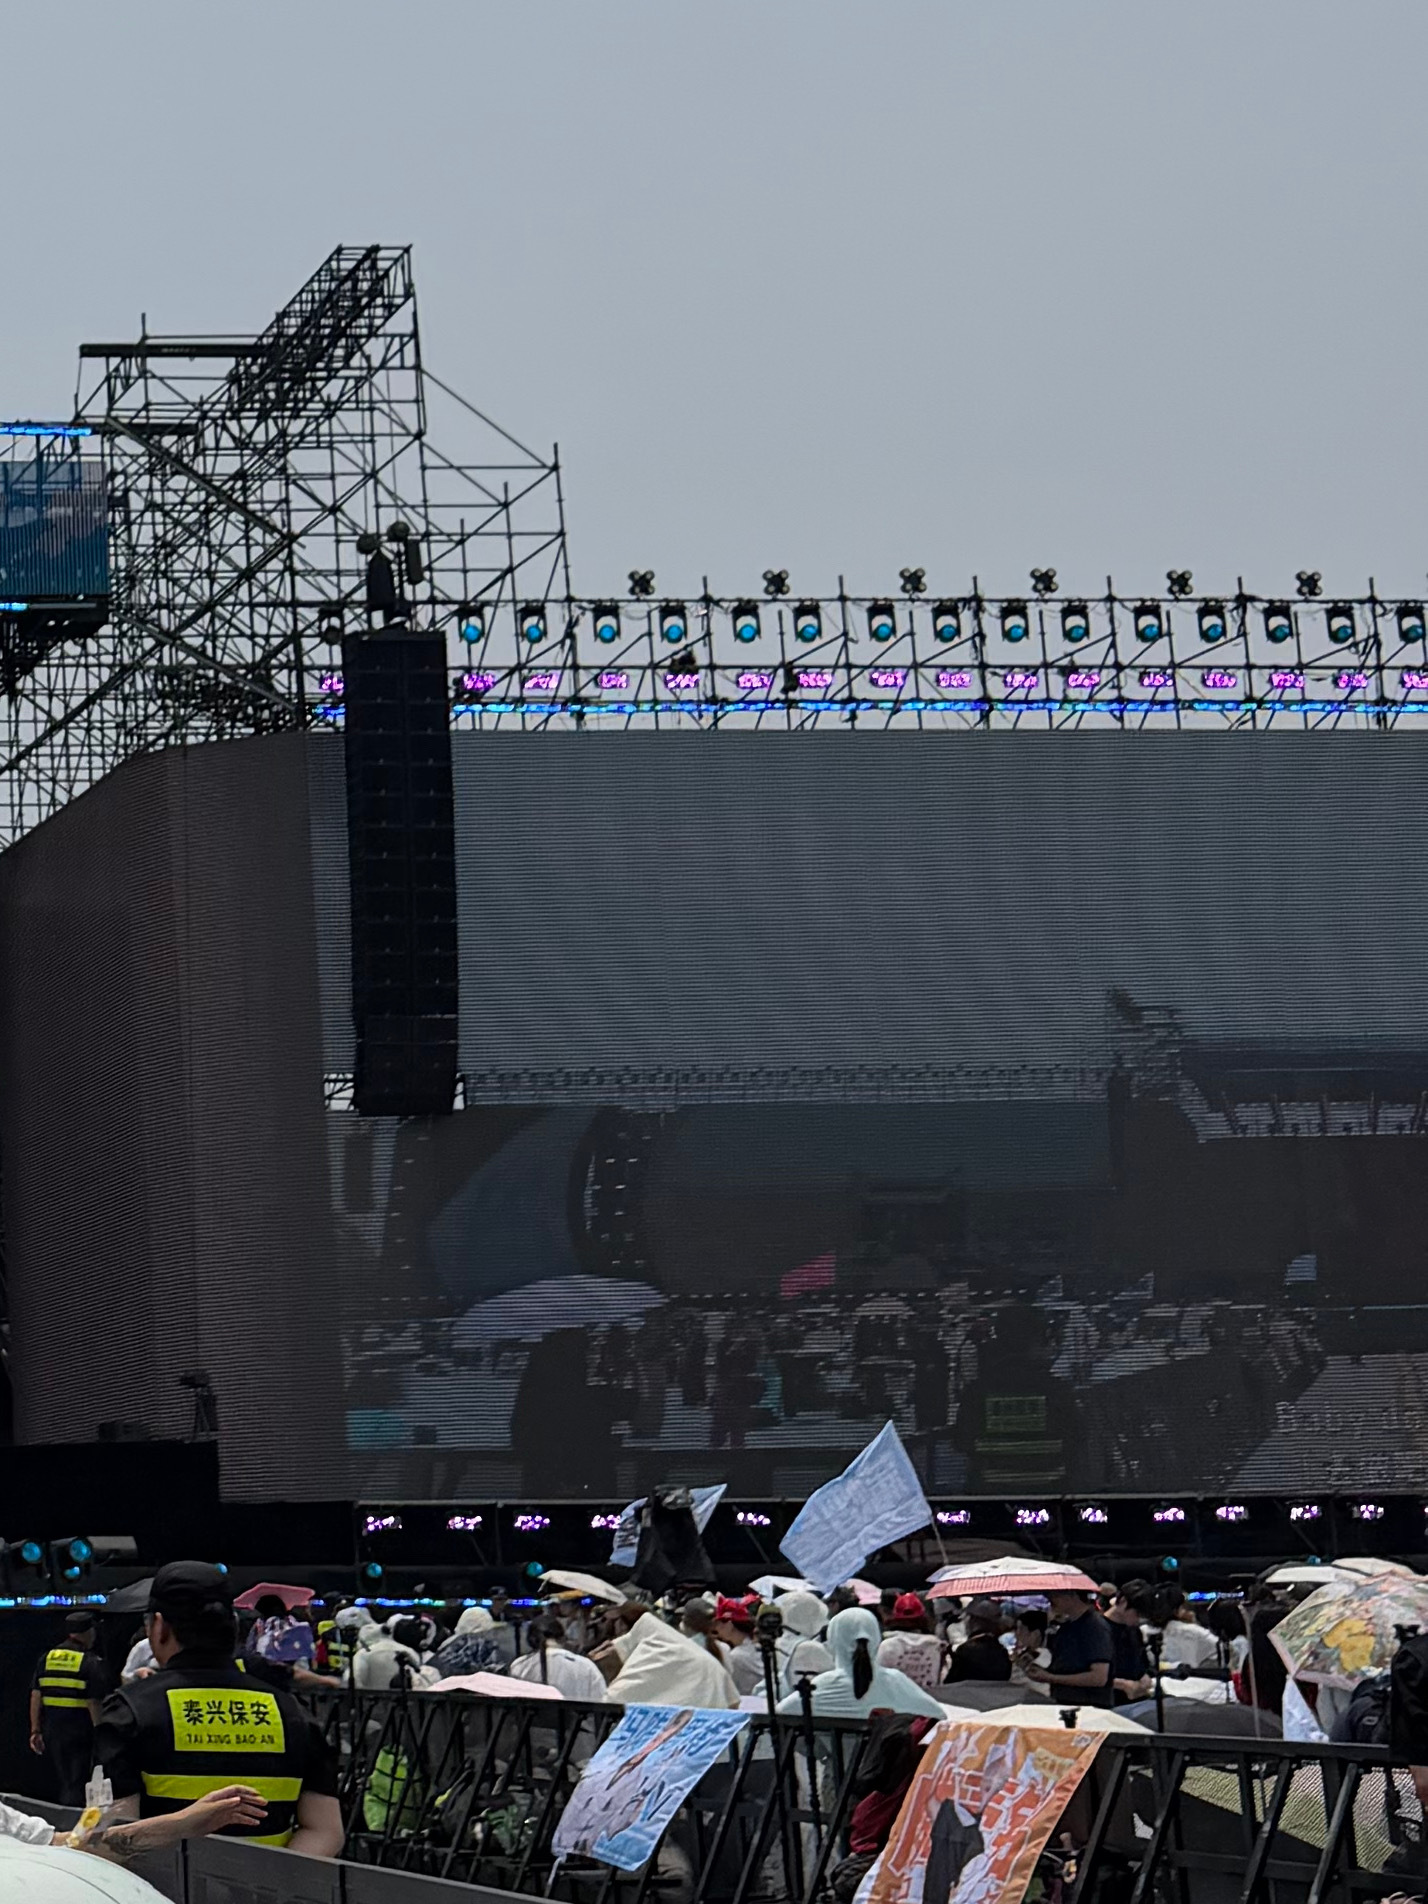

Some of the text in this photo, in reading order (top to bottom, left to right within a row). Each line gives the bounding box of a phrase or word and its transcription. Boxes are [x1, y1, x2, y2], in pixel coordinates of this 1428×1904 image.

[182, 1699, 272, 1727] 泰兴保安
[235, 1733, 257, 1745] BAO
[260, 1733, 275, 1745] AN
